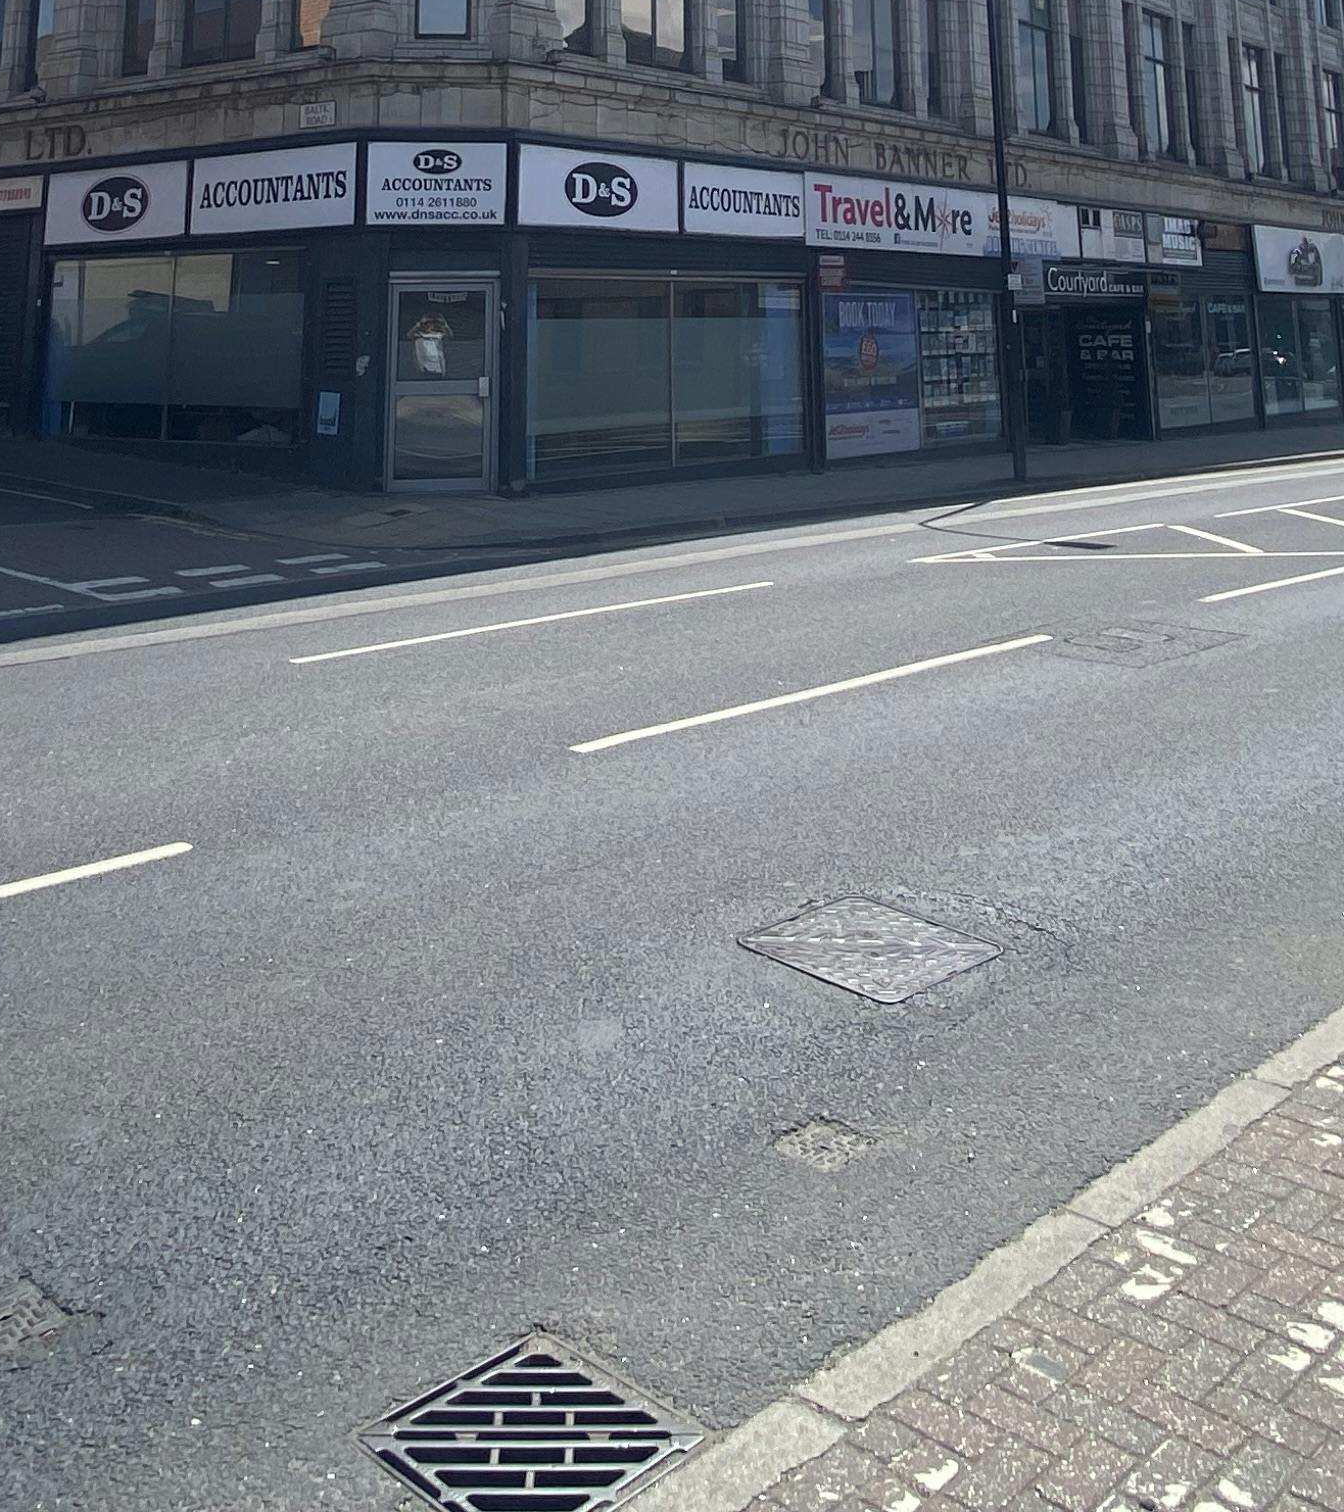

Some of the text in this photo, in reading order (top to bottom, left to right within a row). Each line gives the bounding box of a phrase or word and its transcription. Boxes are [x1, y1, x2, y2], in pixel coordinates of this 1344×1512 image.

[25, 124, 93, 161] LTD.
[418, 154, 458, 170] D&S
[781, 130, 850, 165] JOHN
[874, 143, 971, 181] BANNER
[199, 170, 348, 209] ACCOUNTANTS
[381, 178, 493, 192] ACCOUNTANTS
[571, 173, 632, 207] D&S
[88, 187, 143, 221] D&S
[396, 197, 477, 207] 0114 2611880
[688, 185, 801, 218] ACCOUNTANTS
[374, 209, 497, 220] www.dnsacc.co.uk
[815, 228, 832, 241] TEL:
[851, 232, 865, 243] 244
[1162, 234, 1196, 251] MUSIC
[1047, 267, 1108, 298] Courtyard
[838, 301, 897, 328] BOOK TODAY
[1077, 334, 1134, 348] CAFE
[1079, 349, 1092, 360] &
